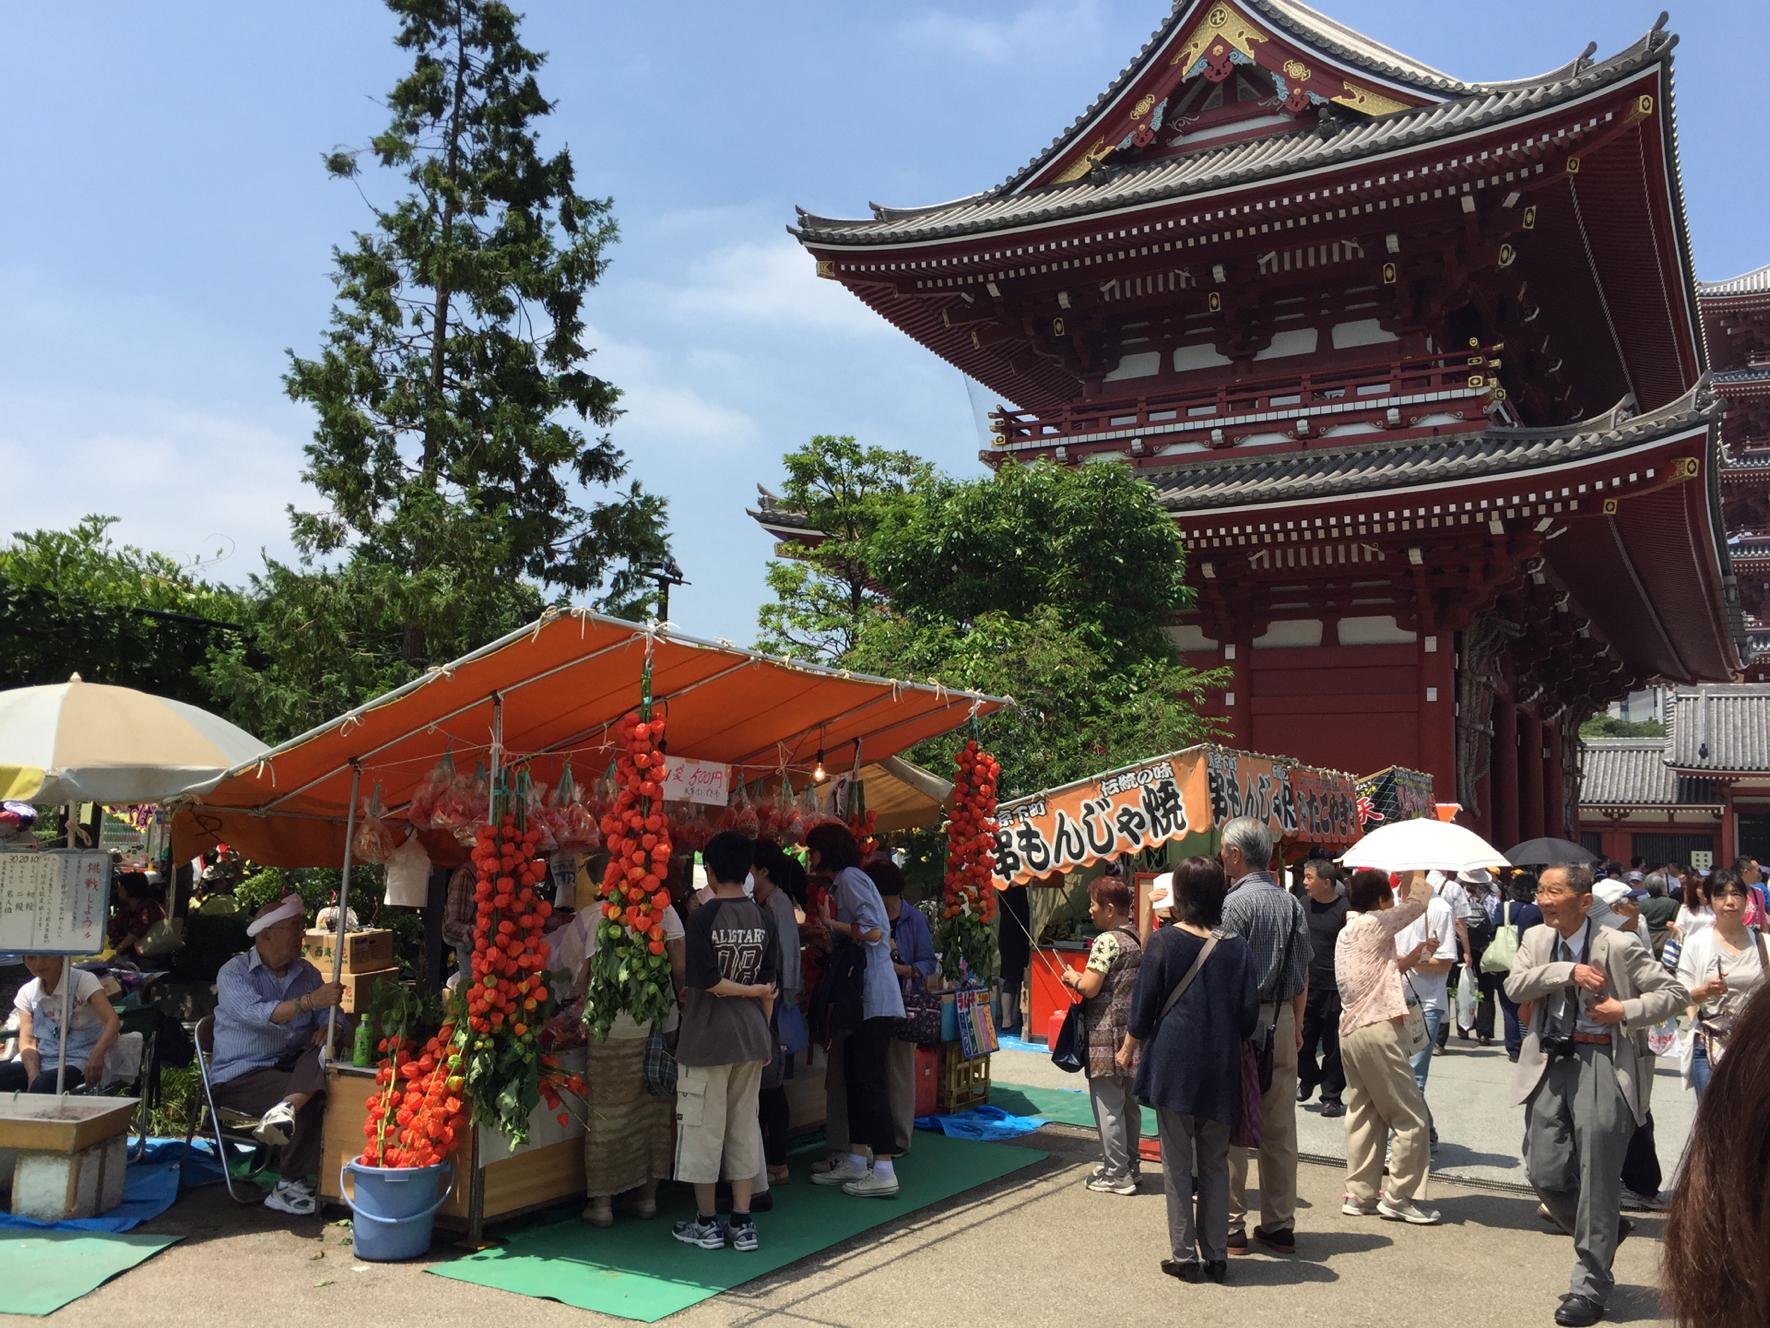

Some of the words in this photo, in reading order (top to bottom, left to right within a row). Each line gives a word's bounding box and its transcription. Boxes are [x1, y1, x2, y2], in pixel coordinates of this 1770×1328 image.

[1100, 761, 1175, 797] 伝統の味
[987, 799, 1047, 829] 京下町
[987, 779, 1189, 884] 串もんじゃ焼
[19, 855, 29, 864] 20
